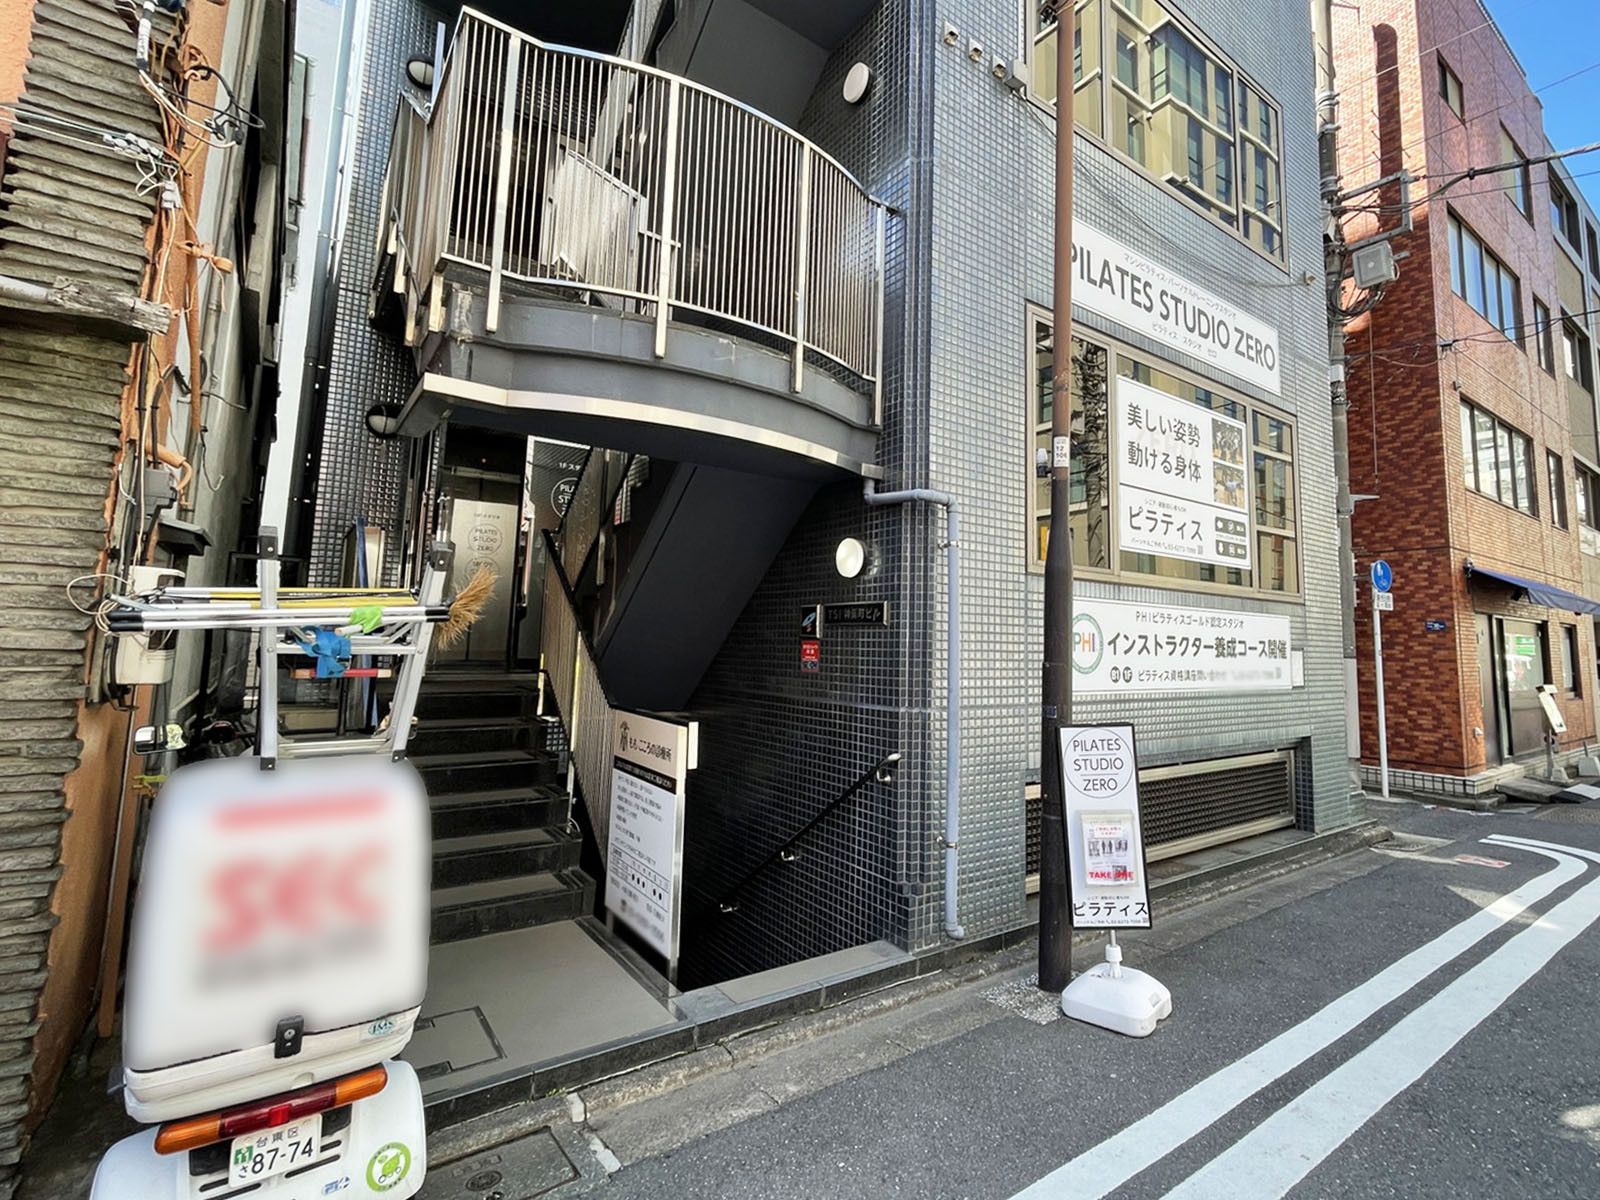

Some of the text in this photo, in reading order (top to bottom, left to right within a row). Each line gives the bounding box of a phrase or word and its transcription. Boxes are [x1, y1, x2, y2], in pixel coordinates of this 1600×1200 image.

[1160, 290, 1230, 349] STUDIO
[1233, 327, 1276, 372] ZERO
[1127, 402, 1201, 448] 美しい姿勢
[1127, 440, 1202, 483] 動ける身体
[1129, 505, 1203, 541] ピラティス
[1072, 631, 1096, 653] PHI
[1107, 632, 1288, 659] インストラクター養成コース開催
[1073, 738, 1121, 752] PILATES
[1073, 757, 1124, 771] STUDIO
[1083, 778, 1118, 791] ZERO
[1089, 871, 1112, 879] TAKE
[1073, 901, 1148, 917] ピラティス
[256, 1127, 299, 1148] 台東区
[238, 1136, 314, 1179] さ 87-74
